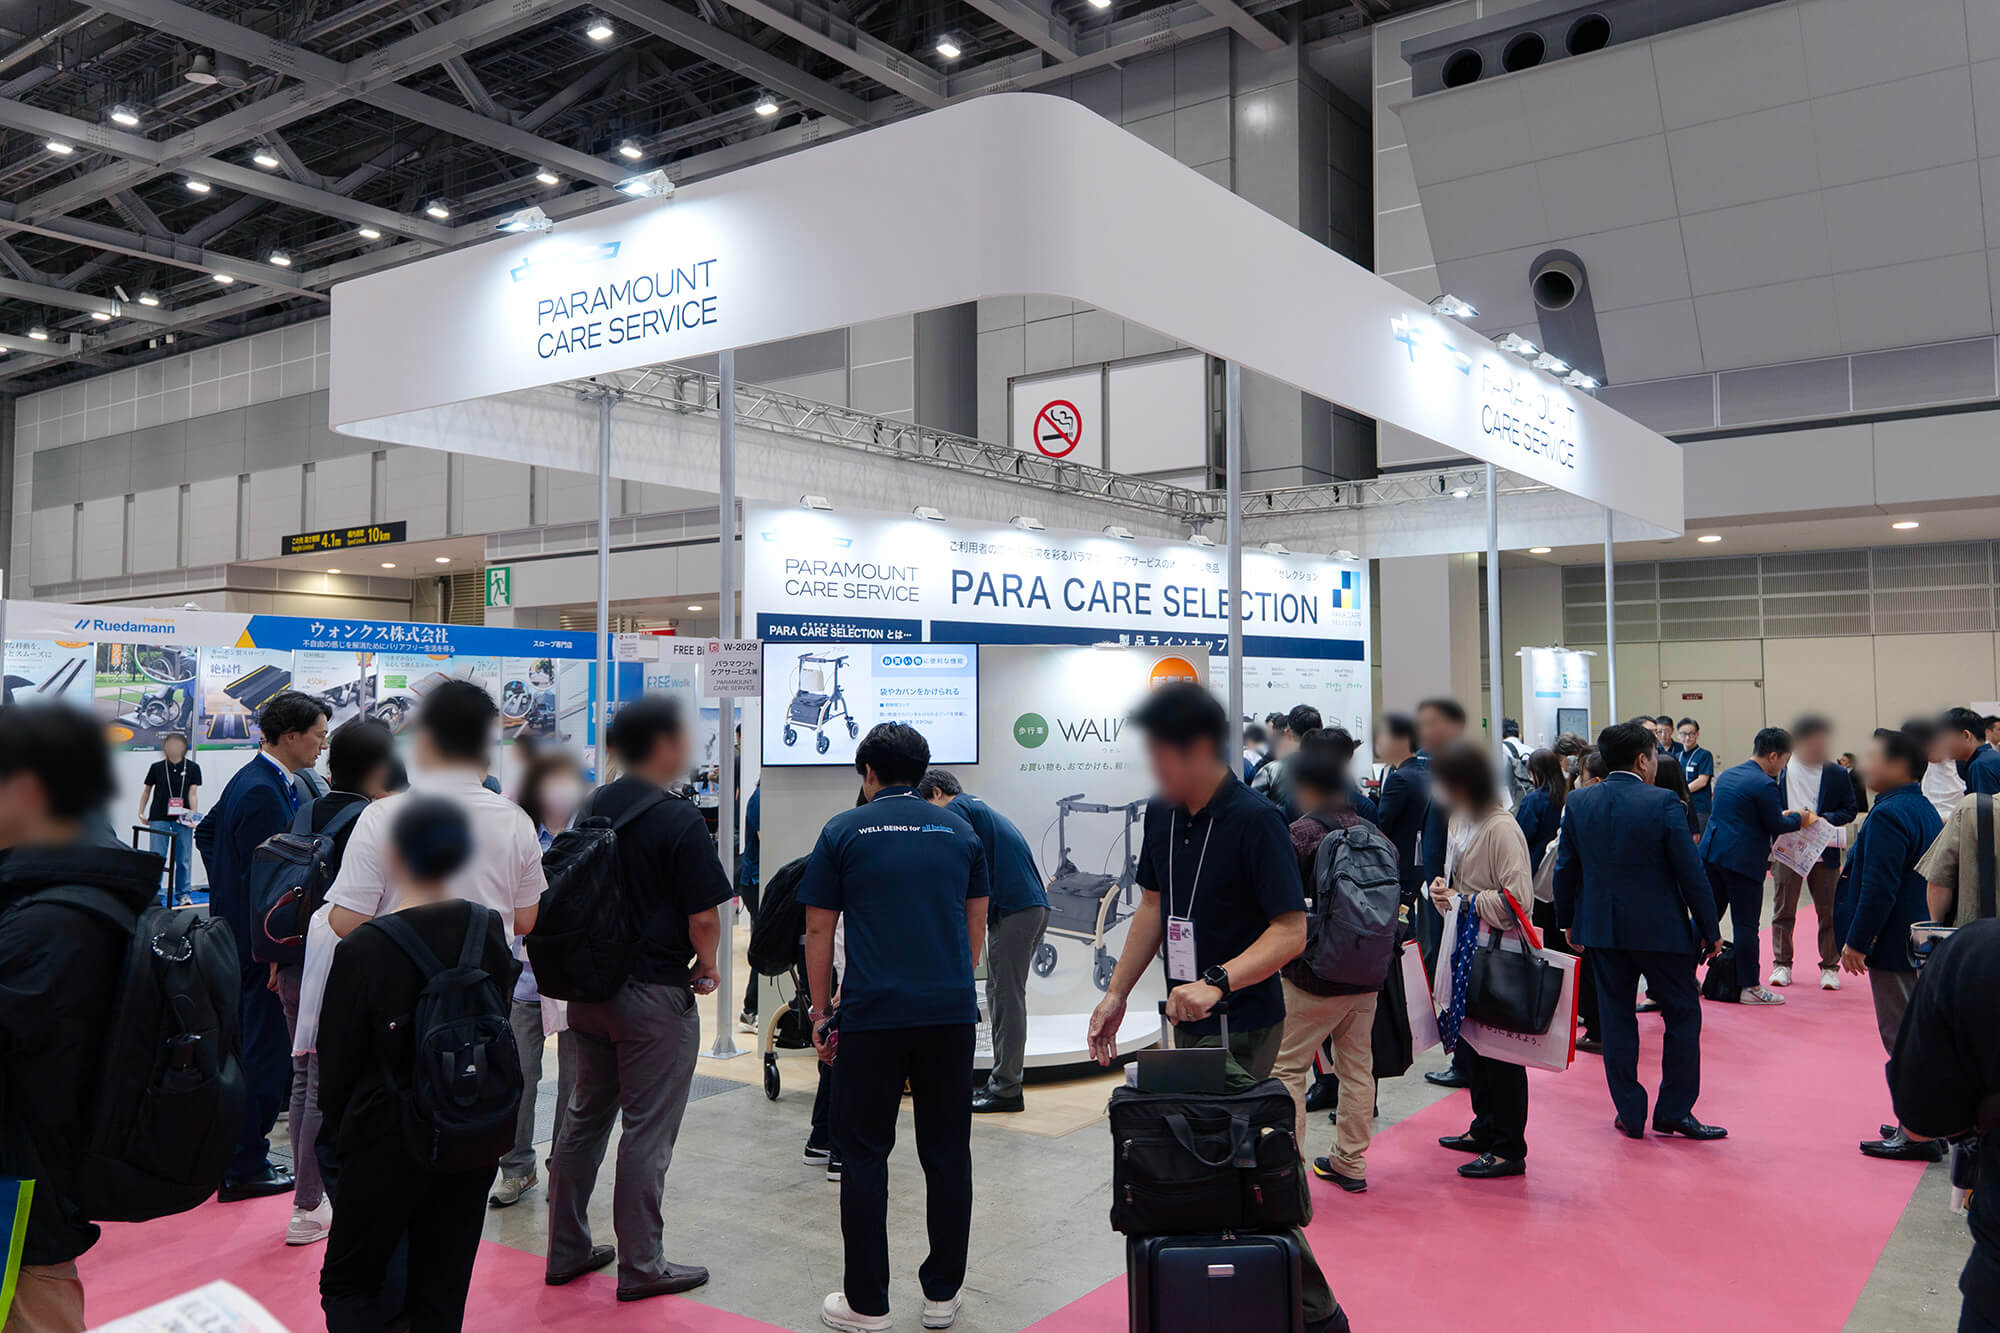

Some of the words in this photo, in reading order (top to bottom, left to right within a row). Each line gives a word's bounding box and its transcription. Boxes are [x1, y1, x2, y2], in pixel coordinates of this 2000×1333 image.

[538, 258, 717, 326] PARAMOUNT
[537, 321, 602, 359] CARE
[608, 295, 718, 344] SERVICE
[1481, 404, 1520, 446] CARE
[1523, 422, 1575, 469] SERVICE
[368, 527, 391, 543] 10km
[785, 558, 919, 582] PARAMOUNT
[785, 579, 839, 598] CARE
[843, 582, 920, 602] SERVICE
[951, 569, 1052, 610] PARA
[1063, 577, 1152, 616] CARE
[1163, 584, 1318, 625] SELECTION
[93, 619, 176, 634] Ruedamann
[310, 621, 449, 644] ウォンクス株式会社
[769, 625, 798, 636] PARA
[800, 626, 828, 638] CARE
[830, 627, 884, 640] SELECTION
[673, 644, 694, 656] FREE
[723, 642, 758, 652] W-2029
[714, 660, 755, 668] パラマウント
[858, 824, 908, 835] WELL-BEING
